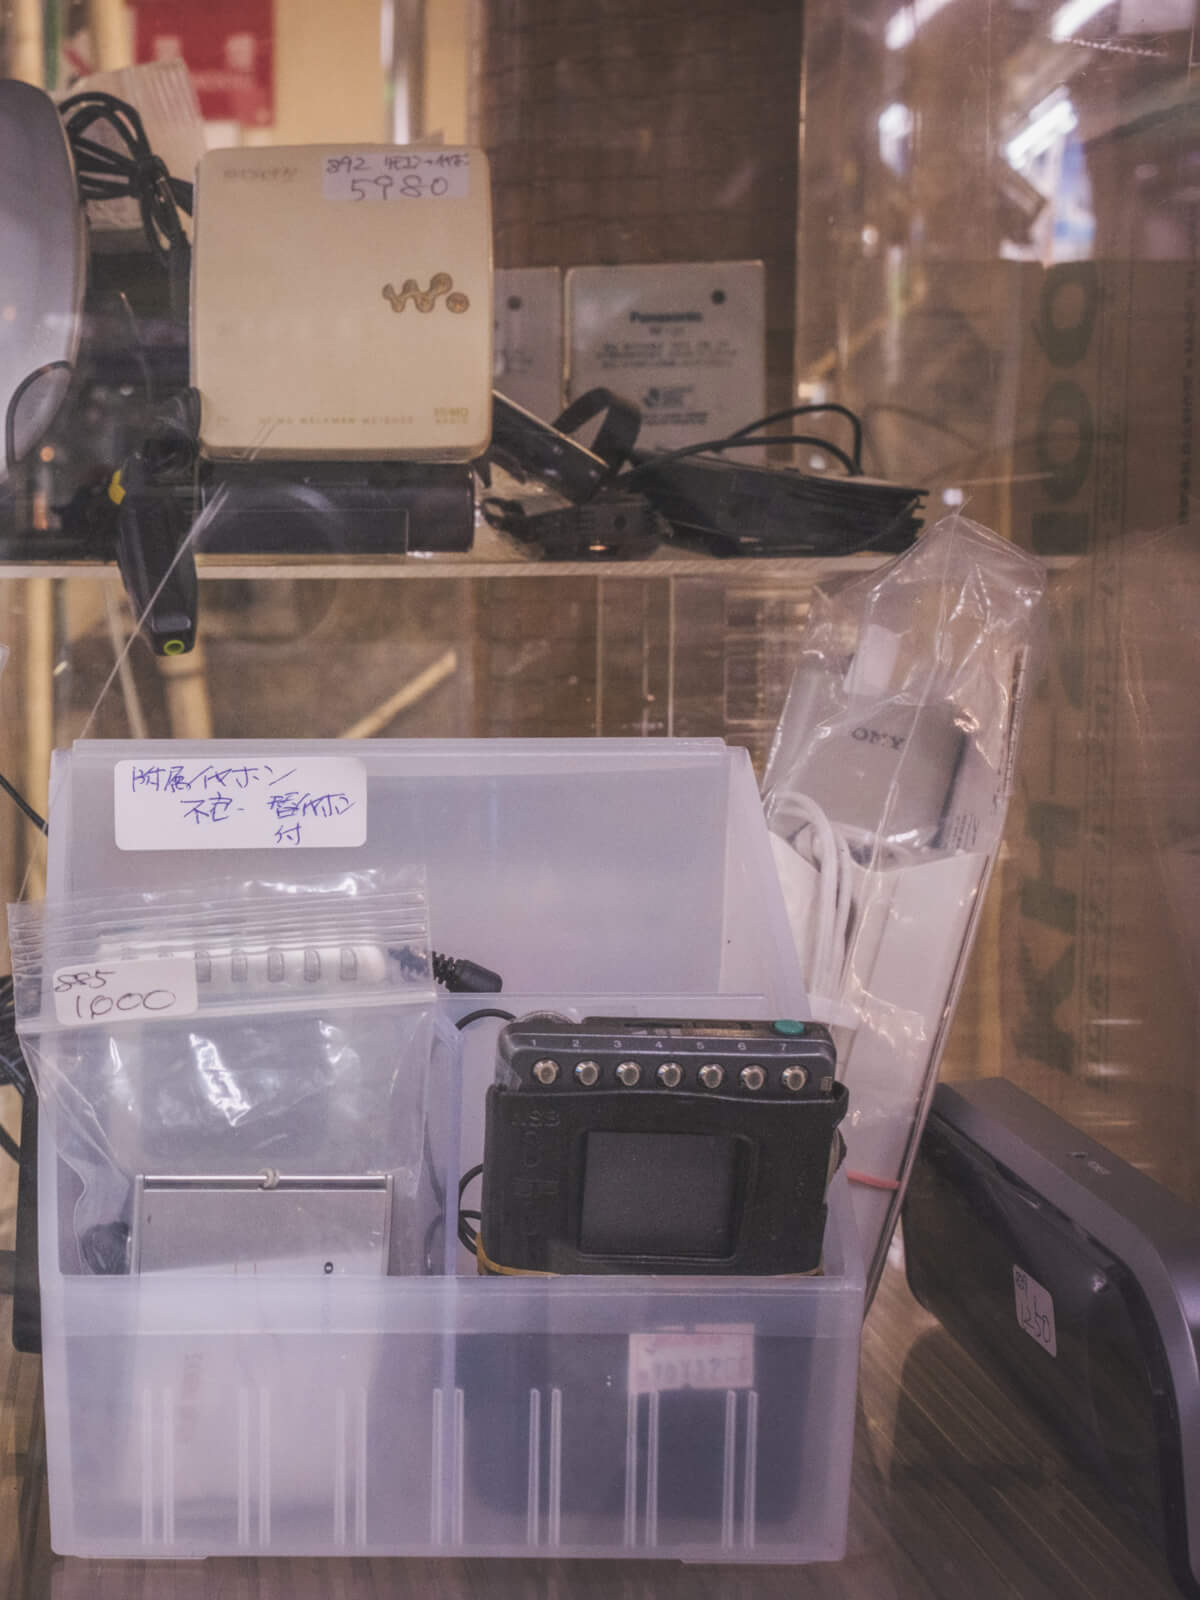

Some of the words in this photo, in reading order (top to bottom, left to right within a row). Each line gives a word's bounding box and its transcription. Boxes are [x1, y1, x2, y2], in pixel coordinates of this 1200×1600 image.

[351, 175, 449, 201] 5980
[572, 1039, 580, 1048] 2
[613, 1040, 622, 1048] 3
[655, 1041, 663, 1049] 4
[696, 1042, 704, 1050] 5
[737, 1042, 746, 1051] 6
[779, 1043, 787, 1052] 7
